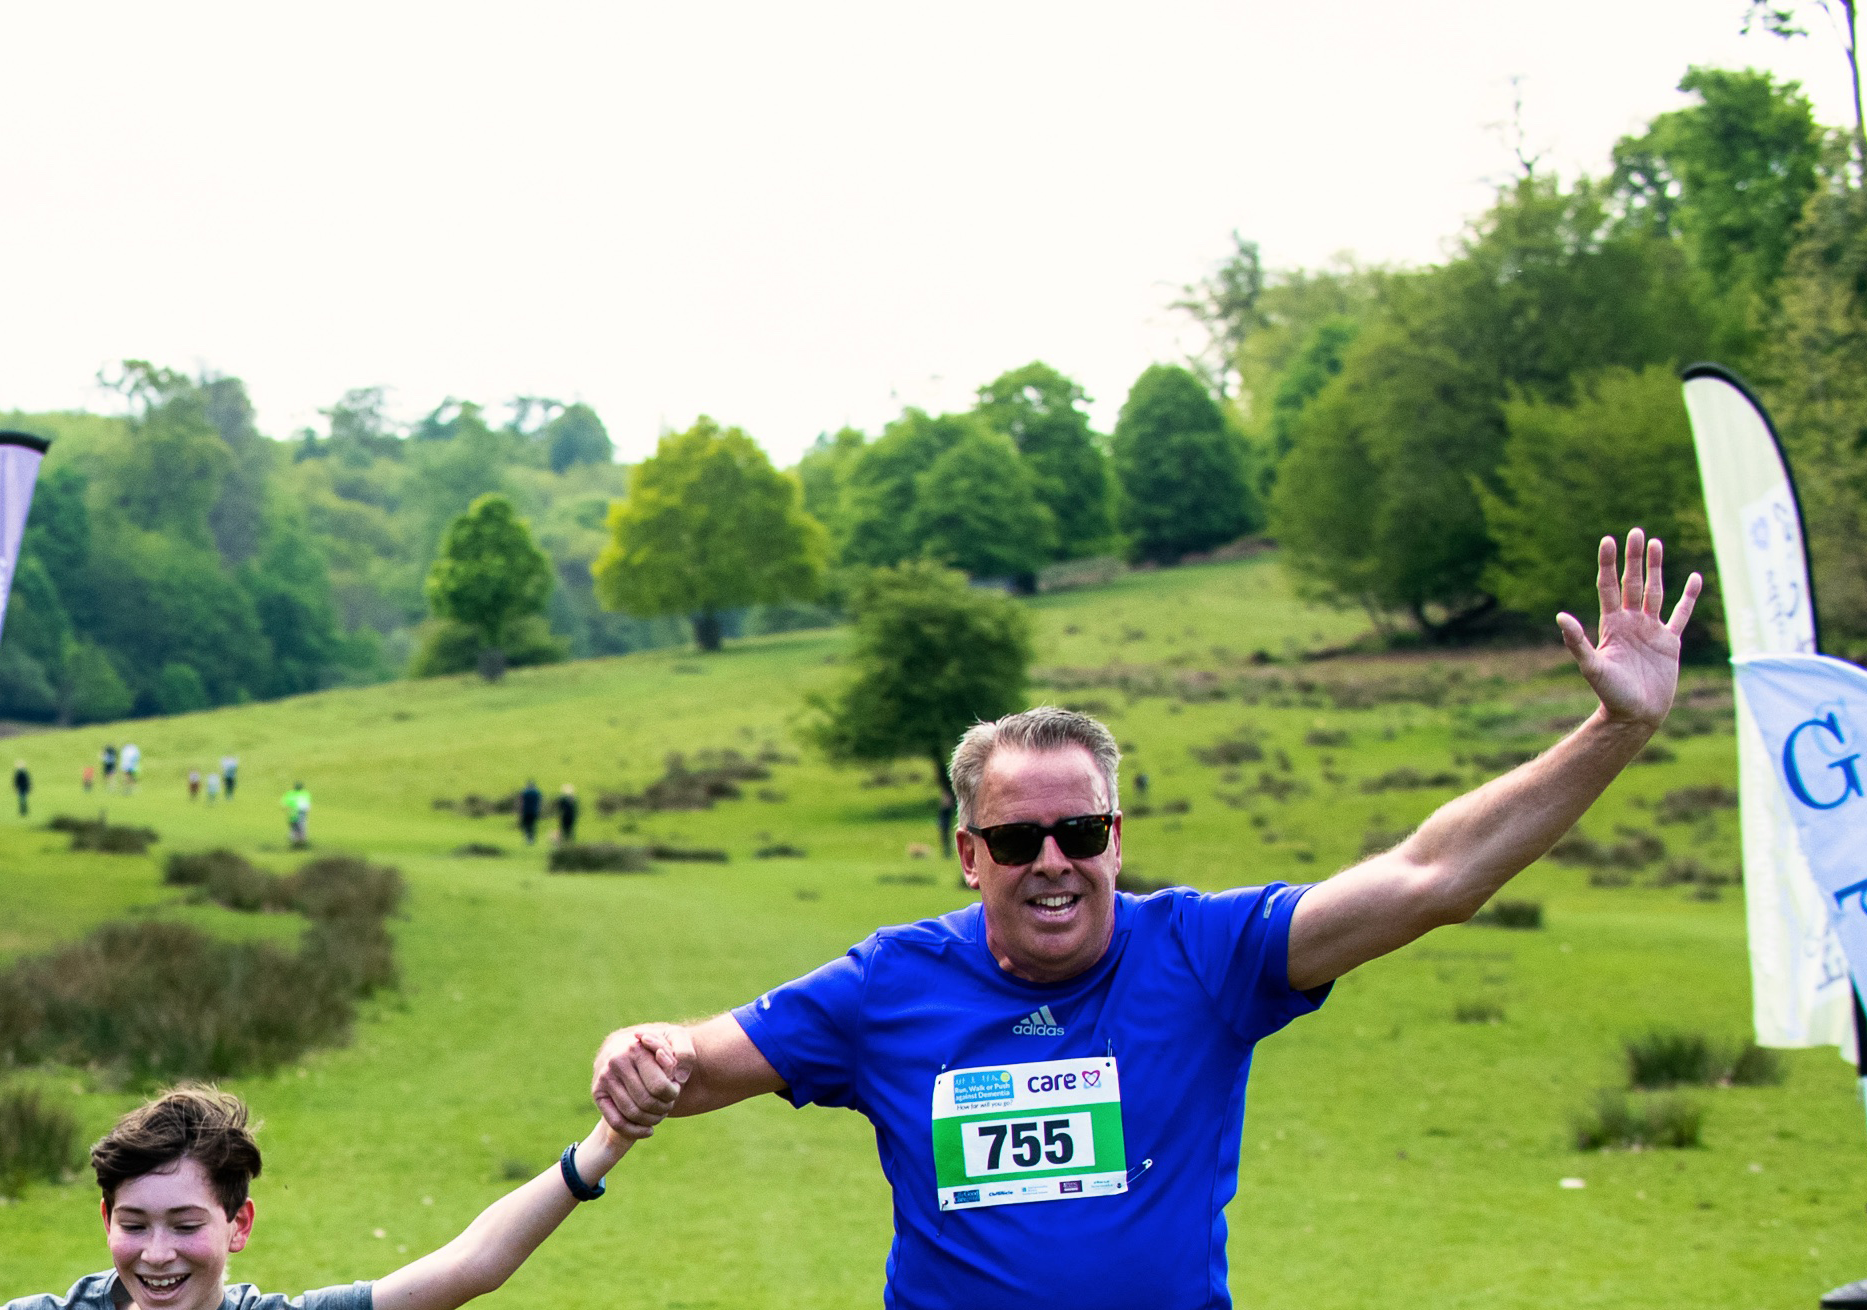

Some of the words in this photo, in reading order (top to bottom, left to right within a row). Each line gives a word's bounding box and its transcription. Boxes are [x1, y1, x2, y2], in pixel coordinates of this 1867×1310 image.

[1012, 1024, 1065, 1037] adidas
[1027, 1073, 1077, 1093] care
[978, 1090, 1010, 1098] Dementia
[978, 1119, 1074, 1170] 755
